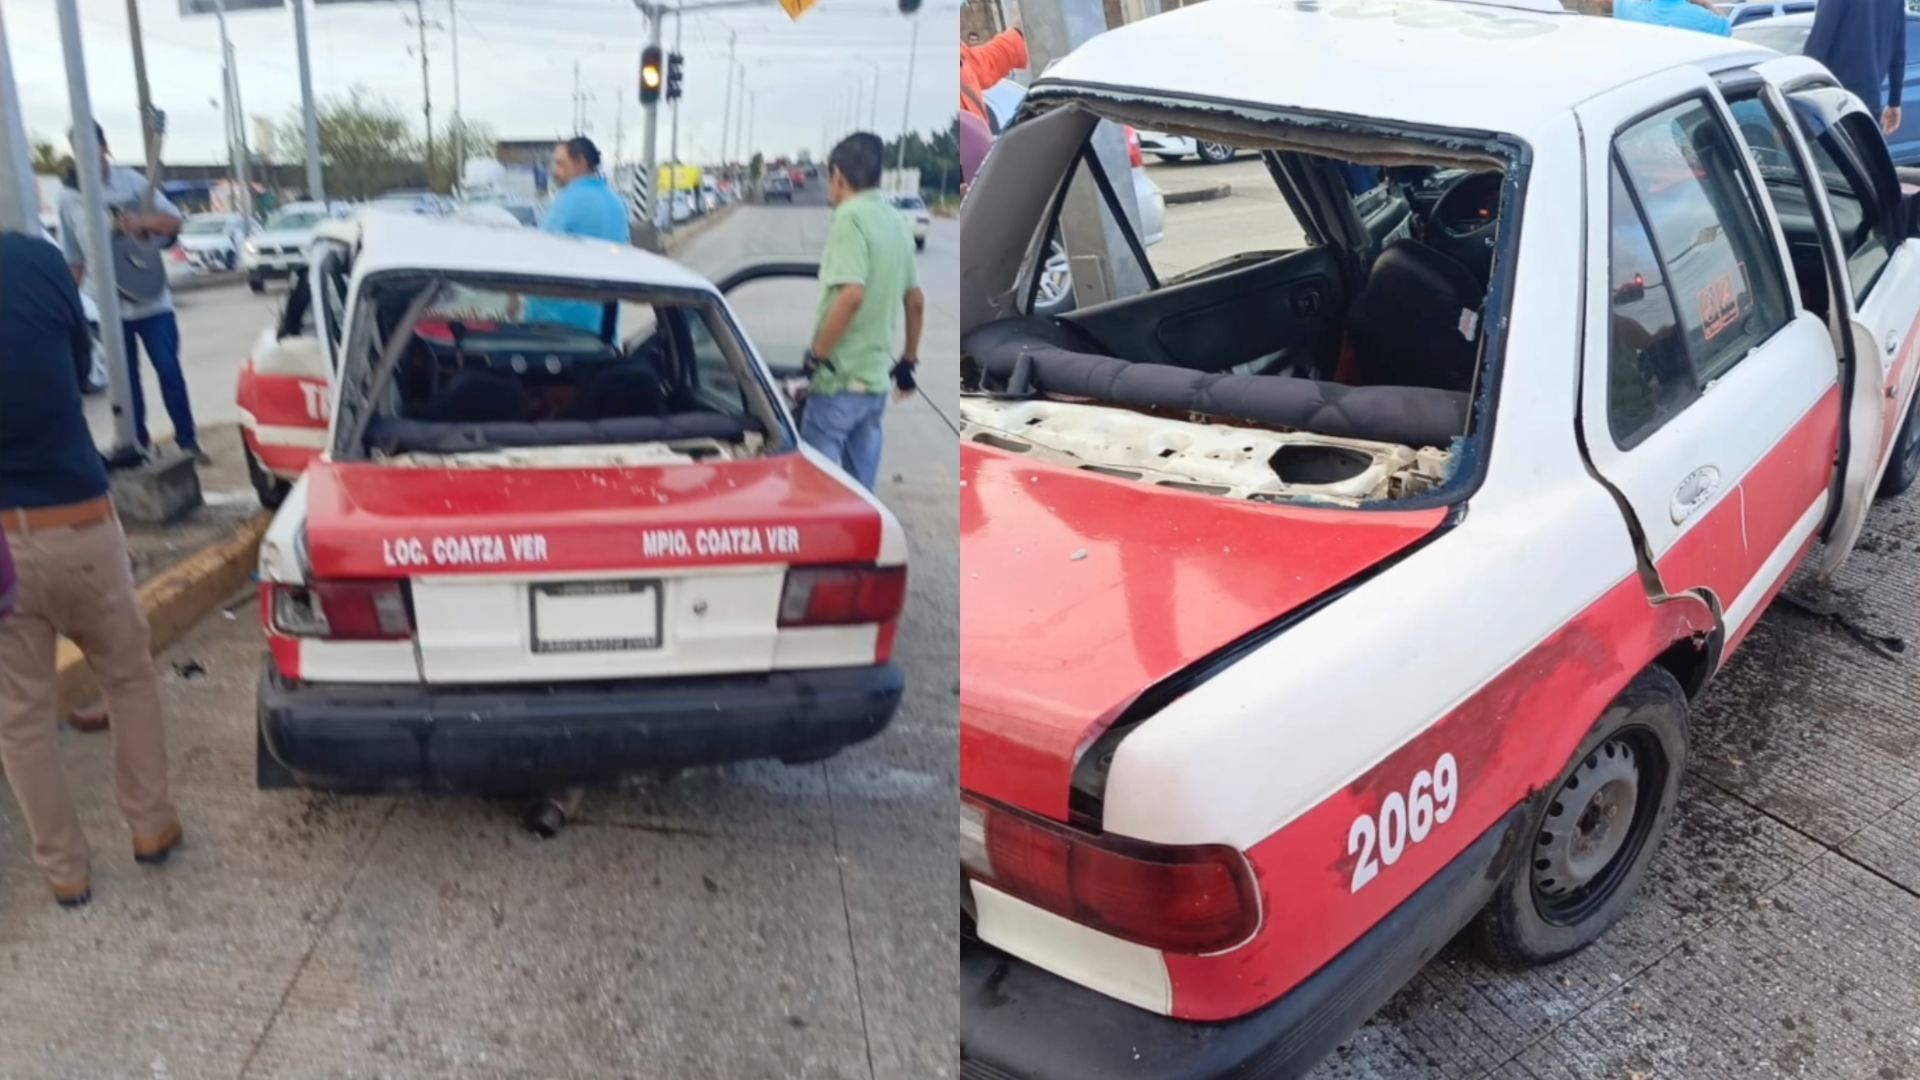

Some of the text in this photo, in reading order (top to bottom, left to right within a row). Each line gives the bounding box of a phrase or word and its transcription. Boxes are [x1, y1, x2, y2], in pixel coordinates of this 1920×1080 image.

[432, 535, 507, 564] COATZA
[510, 533, 548, 561] VER
[642, 525, 799, 557] MPIO. COATZA VER
[1347, 752, 1458, 894] 2069
